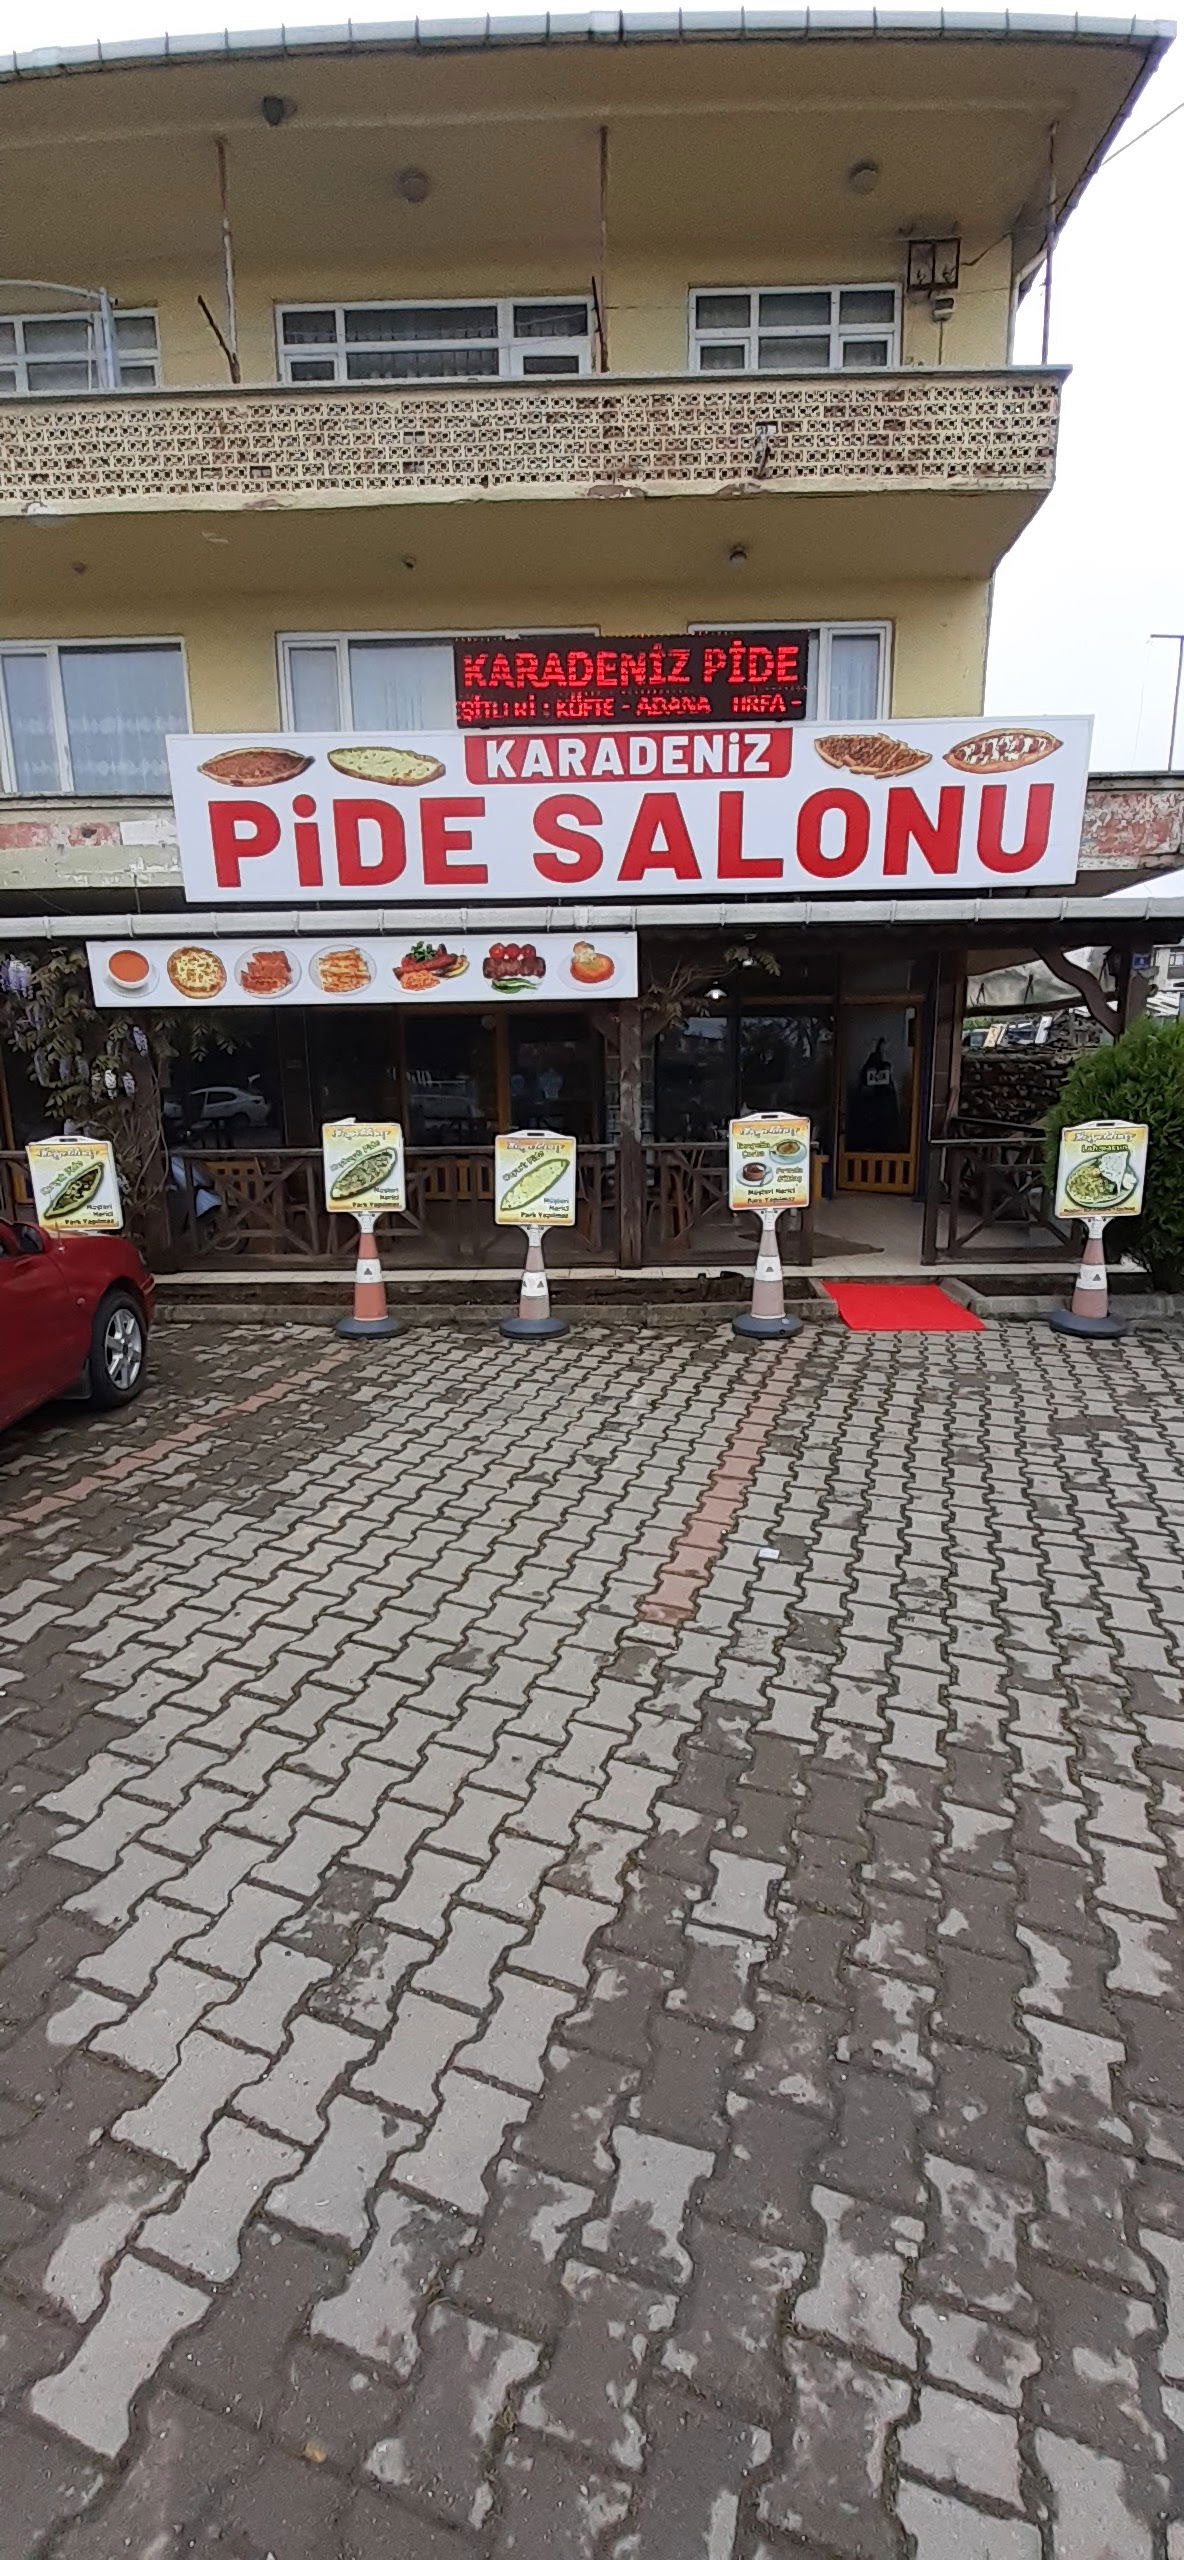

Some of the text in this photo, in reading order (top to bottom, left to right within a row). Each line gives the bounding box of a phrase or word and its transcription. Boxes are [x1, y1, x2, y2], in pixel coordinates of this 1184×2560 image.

[462, 638, 800, 689] KARADENİZ PİDE
[532, 782, 1055, 884] SALONU
